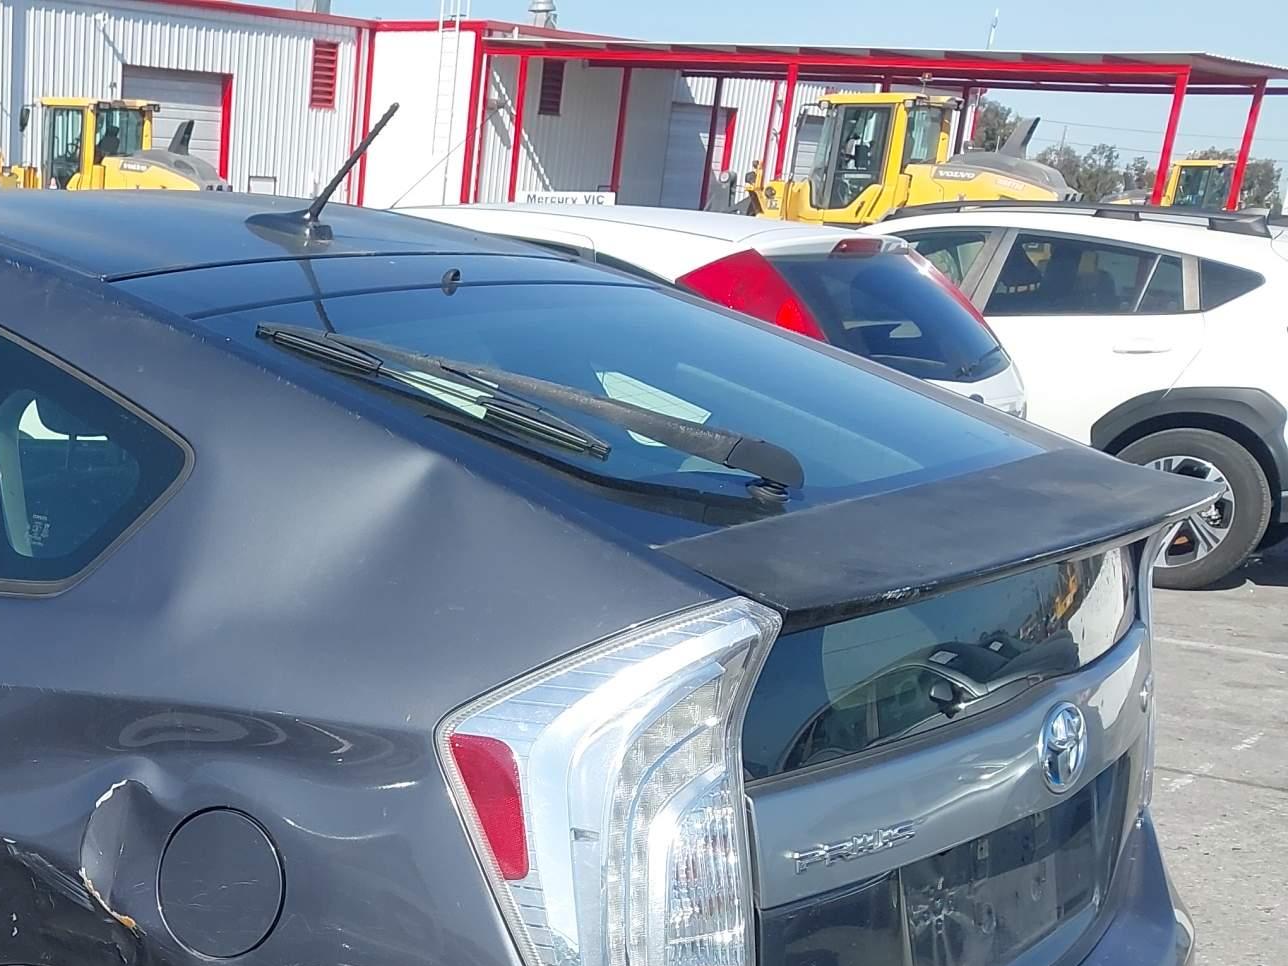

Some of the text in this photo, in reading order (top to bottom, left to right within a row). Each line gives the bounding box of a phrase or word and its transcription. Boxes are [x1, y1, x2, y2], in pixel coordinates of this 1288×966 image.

[938, 170, 975, 179] VOLVO
[527, 194, 605, 205] Mercury VIC
[792, 822, 916, 875] PRIUS
